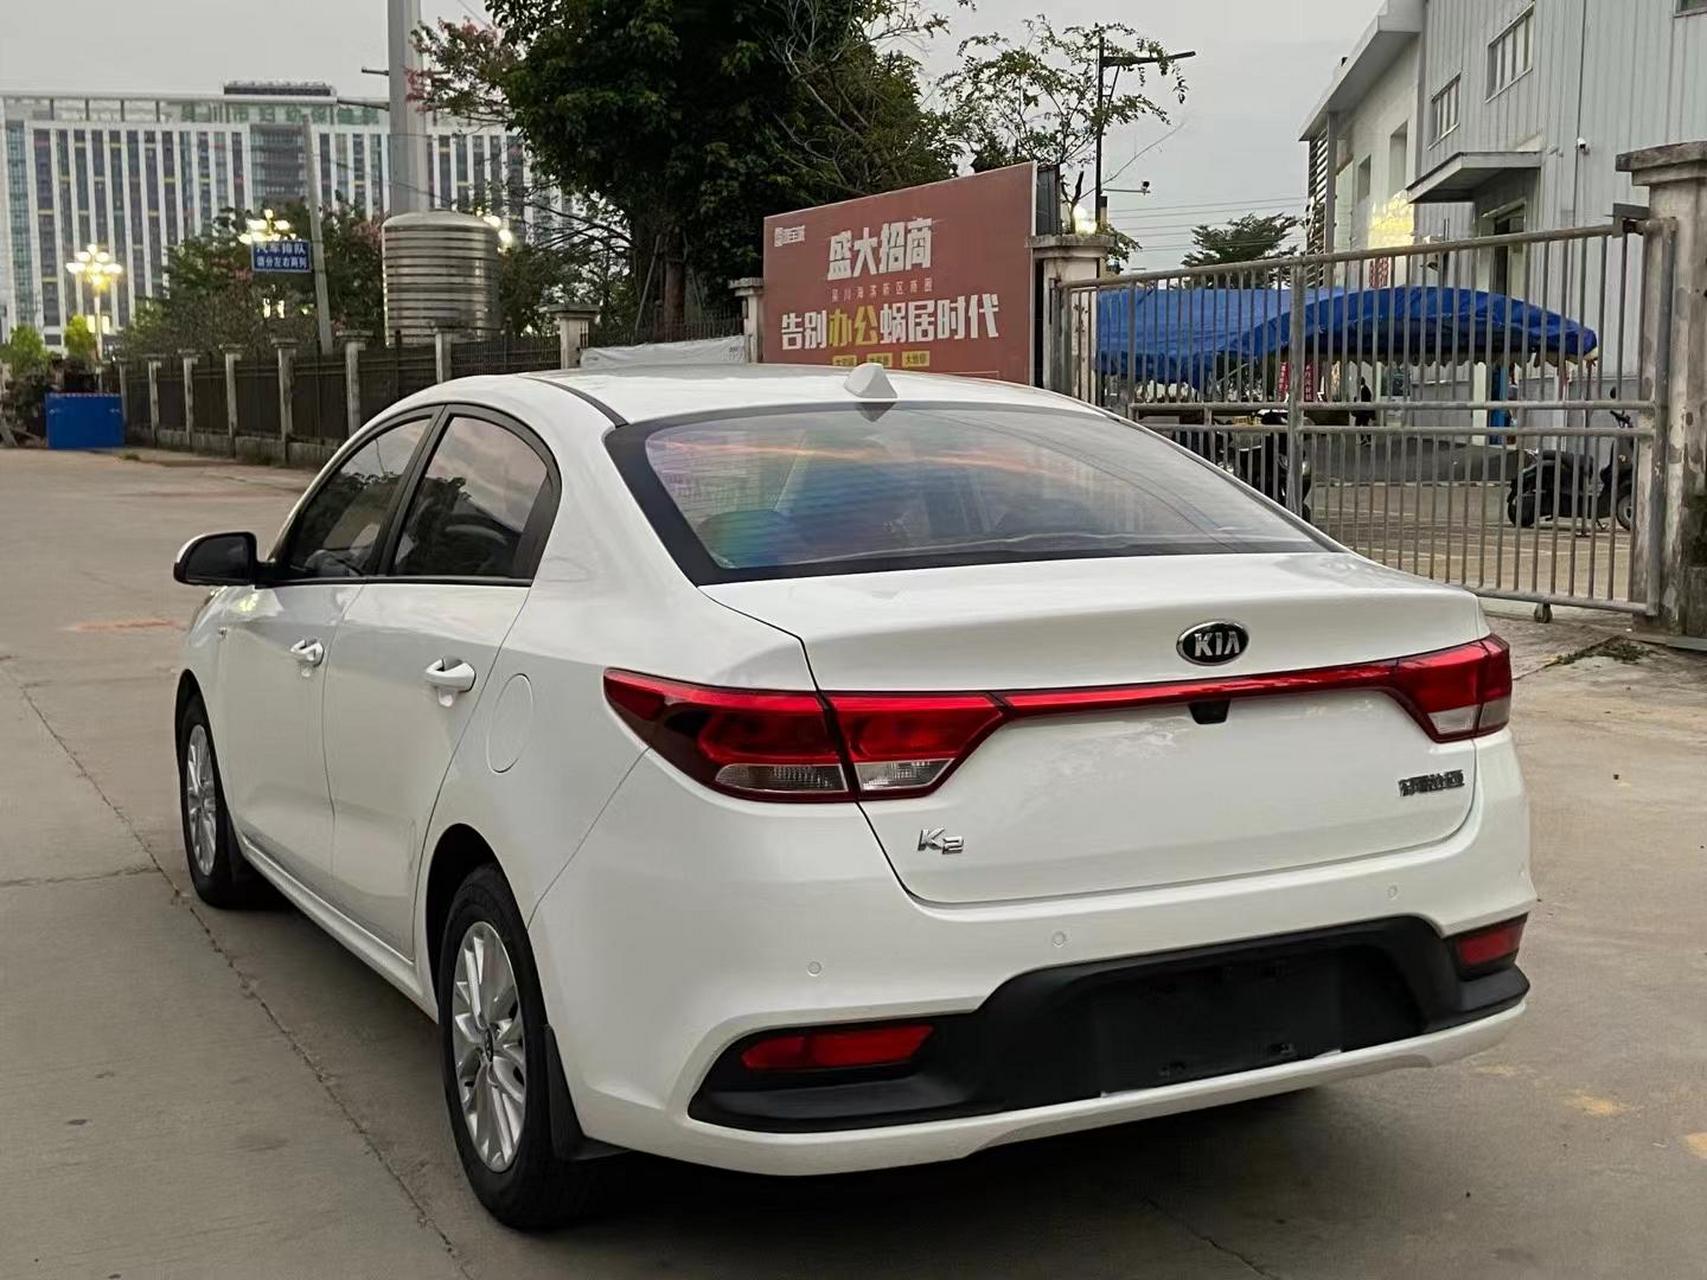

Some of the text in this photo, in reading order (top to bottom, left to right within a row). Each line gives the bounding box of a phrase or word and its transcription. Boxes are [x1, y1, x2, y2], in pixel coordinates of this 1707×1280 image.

[827, 217, 933, 281] 盛大招商
[781, 293, 999, 350] 告别办公蜗居时代
[1193, 630, 1241, 657] KIA
[917, 828, 964, 855] K2
